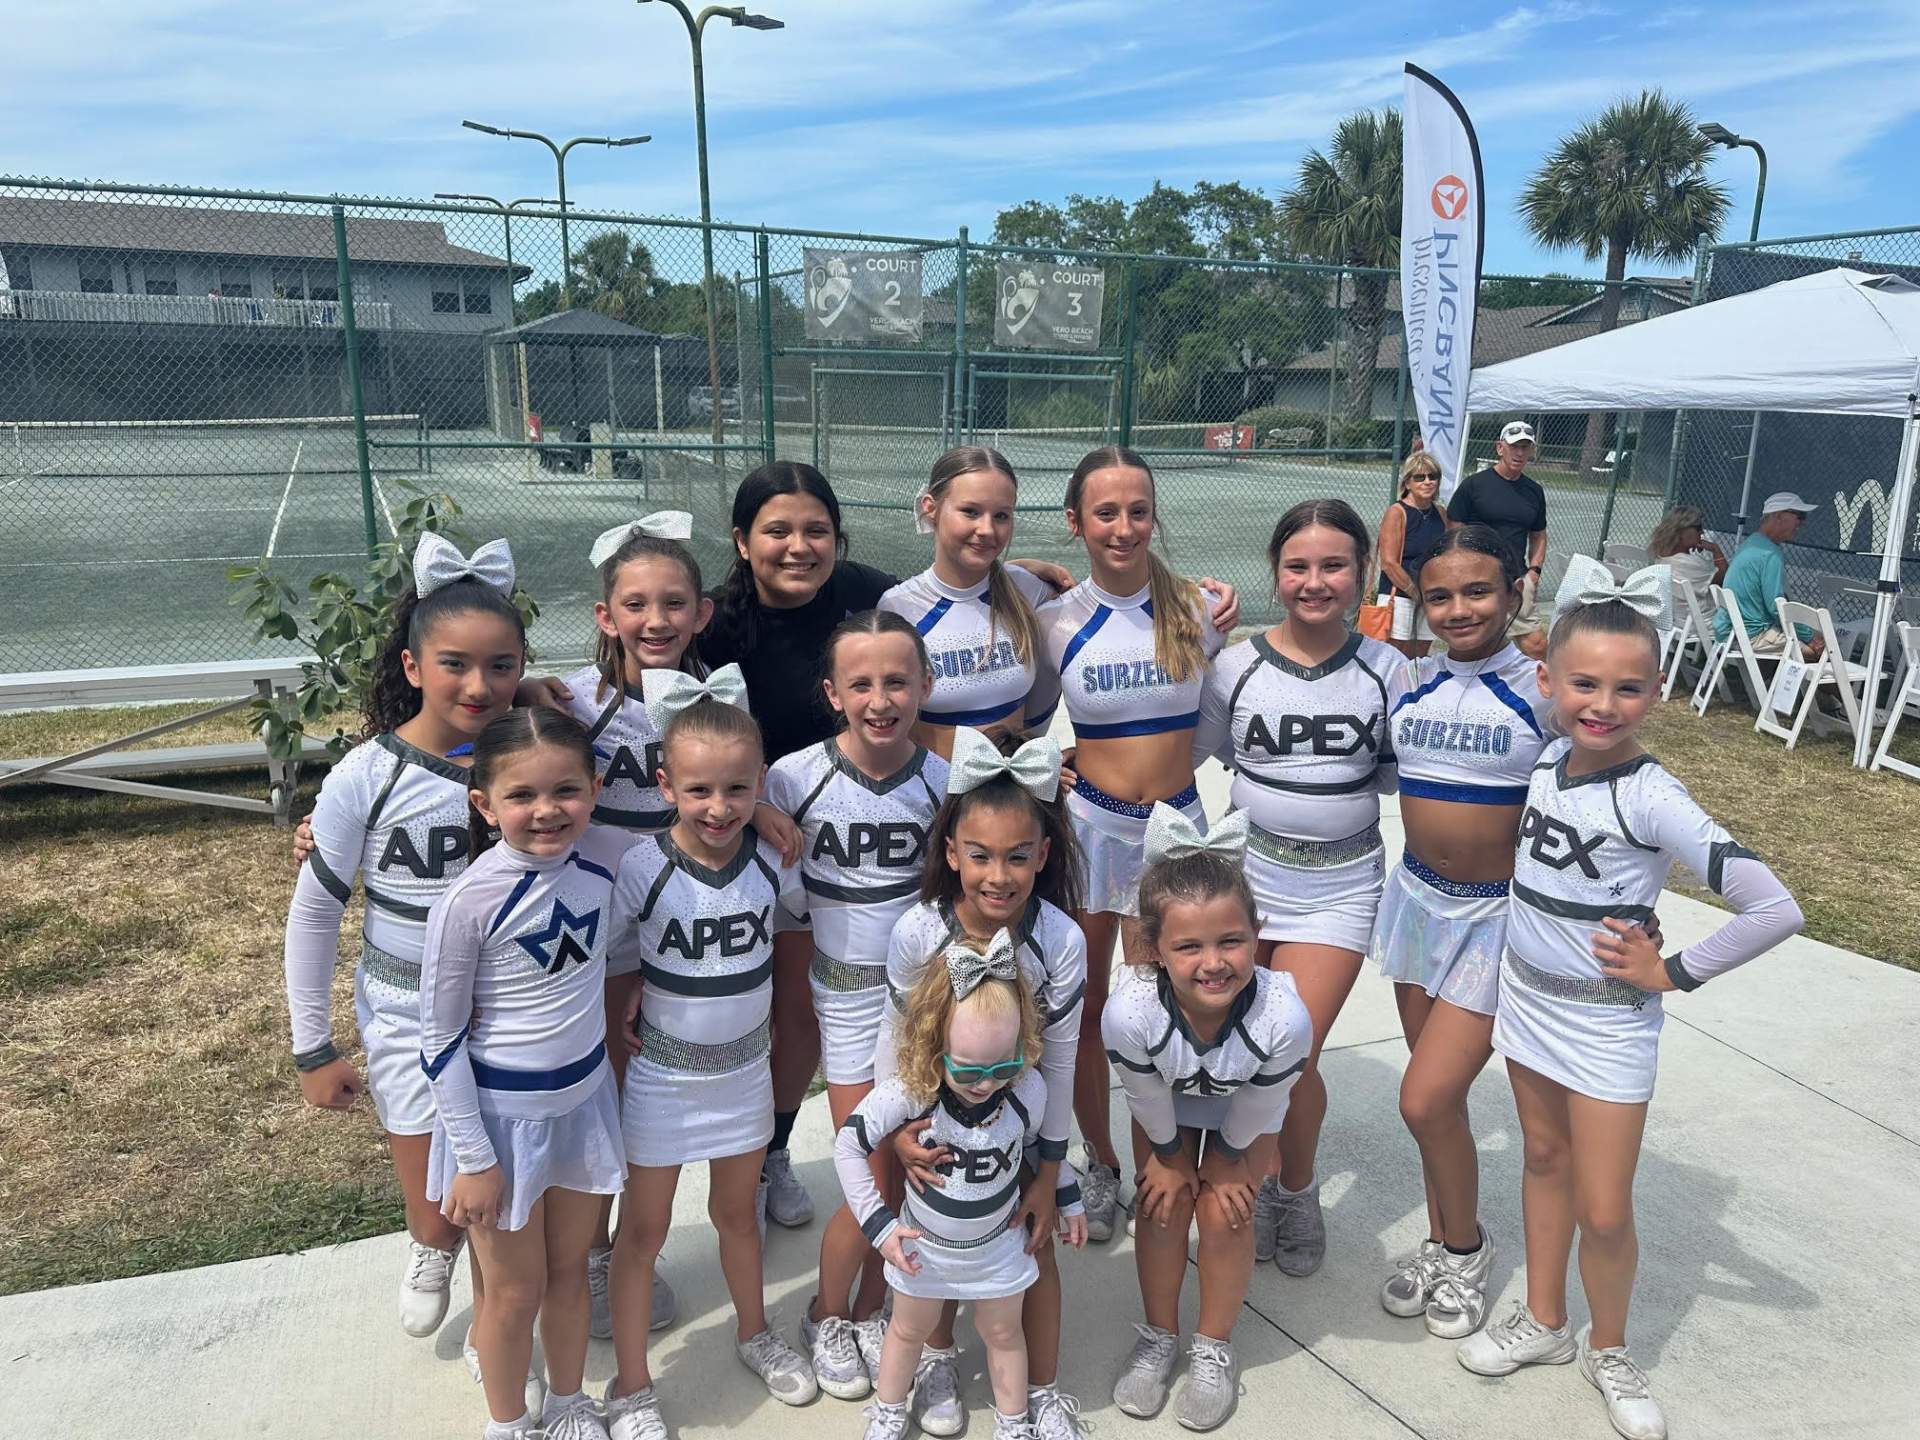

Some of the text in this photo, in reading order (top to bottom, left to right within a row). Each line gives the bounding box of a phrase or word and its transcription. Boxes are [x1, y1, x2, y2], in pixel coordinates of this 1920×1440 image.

[865, 258, 917, 273] COURT
[1052, 271, 1100, 286] COURT
[884, 281, 901, 306] 2
[1066, 292, 1082, 316] 3
[1083, 660, 1189, 693] SUBZER
[1243, 712, 1379, 756] APEX
[1398, 716, 1512, 756] SUBZERO
[602, 741, 664, 788] AP
[378, 826, 469, 879] AP
[1516, 806, 1607, 879] PEX
[657, 904, 770, 960] APEX
[923, 1138, 1016, 1184] PEX
